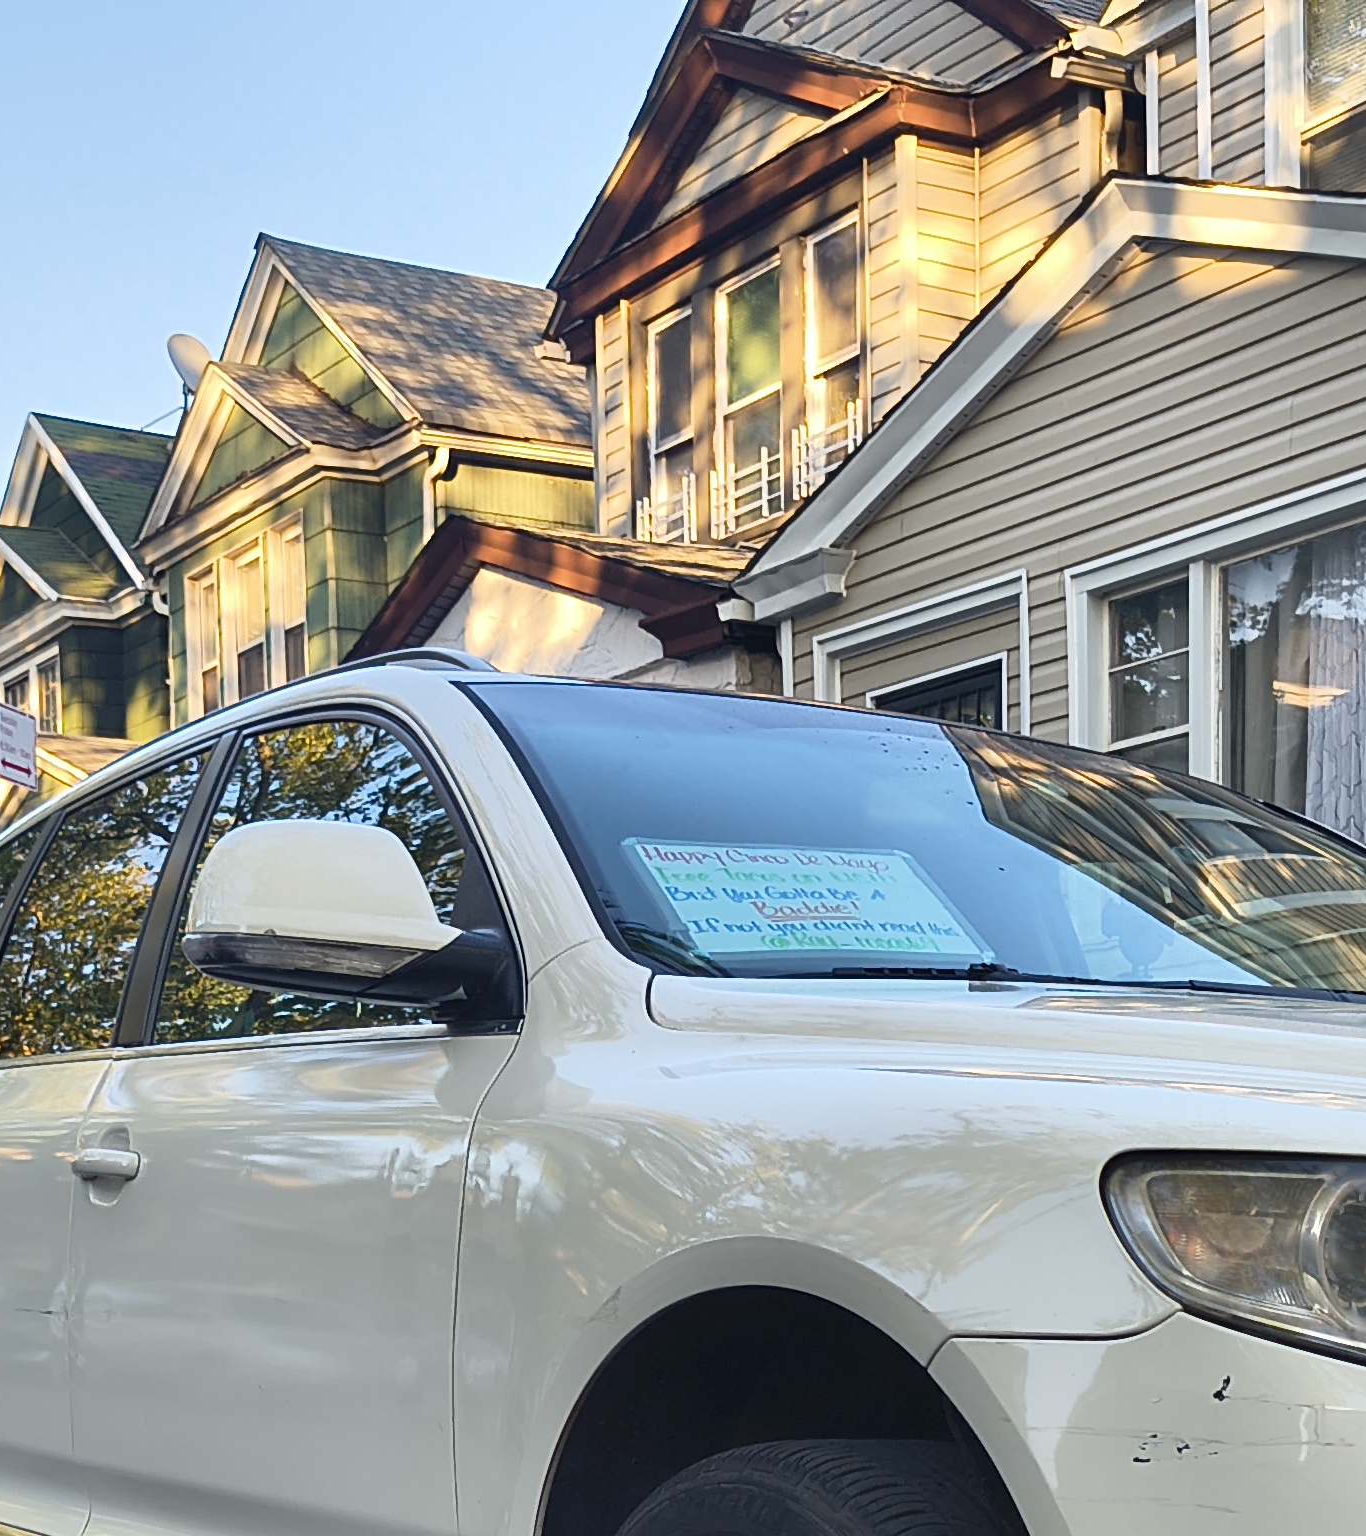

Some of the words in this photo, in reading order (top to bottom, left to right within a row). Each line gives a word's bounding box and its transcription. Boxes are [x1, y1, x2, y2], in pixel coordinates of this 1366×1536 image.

[640, 846, 727, 866] Happy
[726, 849, 789, 864] Cinco
[792, 851, 823, 865] De
[823, 854, 889, 874] Mayo
[651, 865, 711, 884] Free
[721, 887, 765, 903] You
[870, 888, 886, 900] A
[748, 900, 862, 919] Baddie!
[687, 917, 720, 933] If
[723, 920, 763, 933] not
[767, 921, 809, 936] you
[878, 920, 927, 935] read
